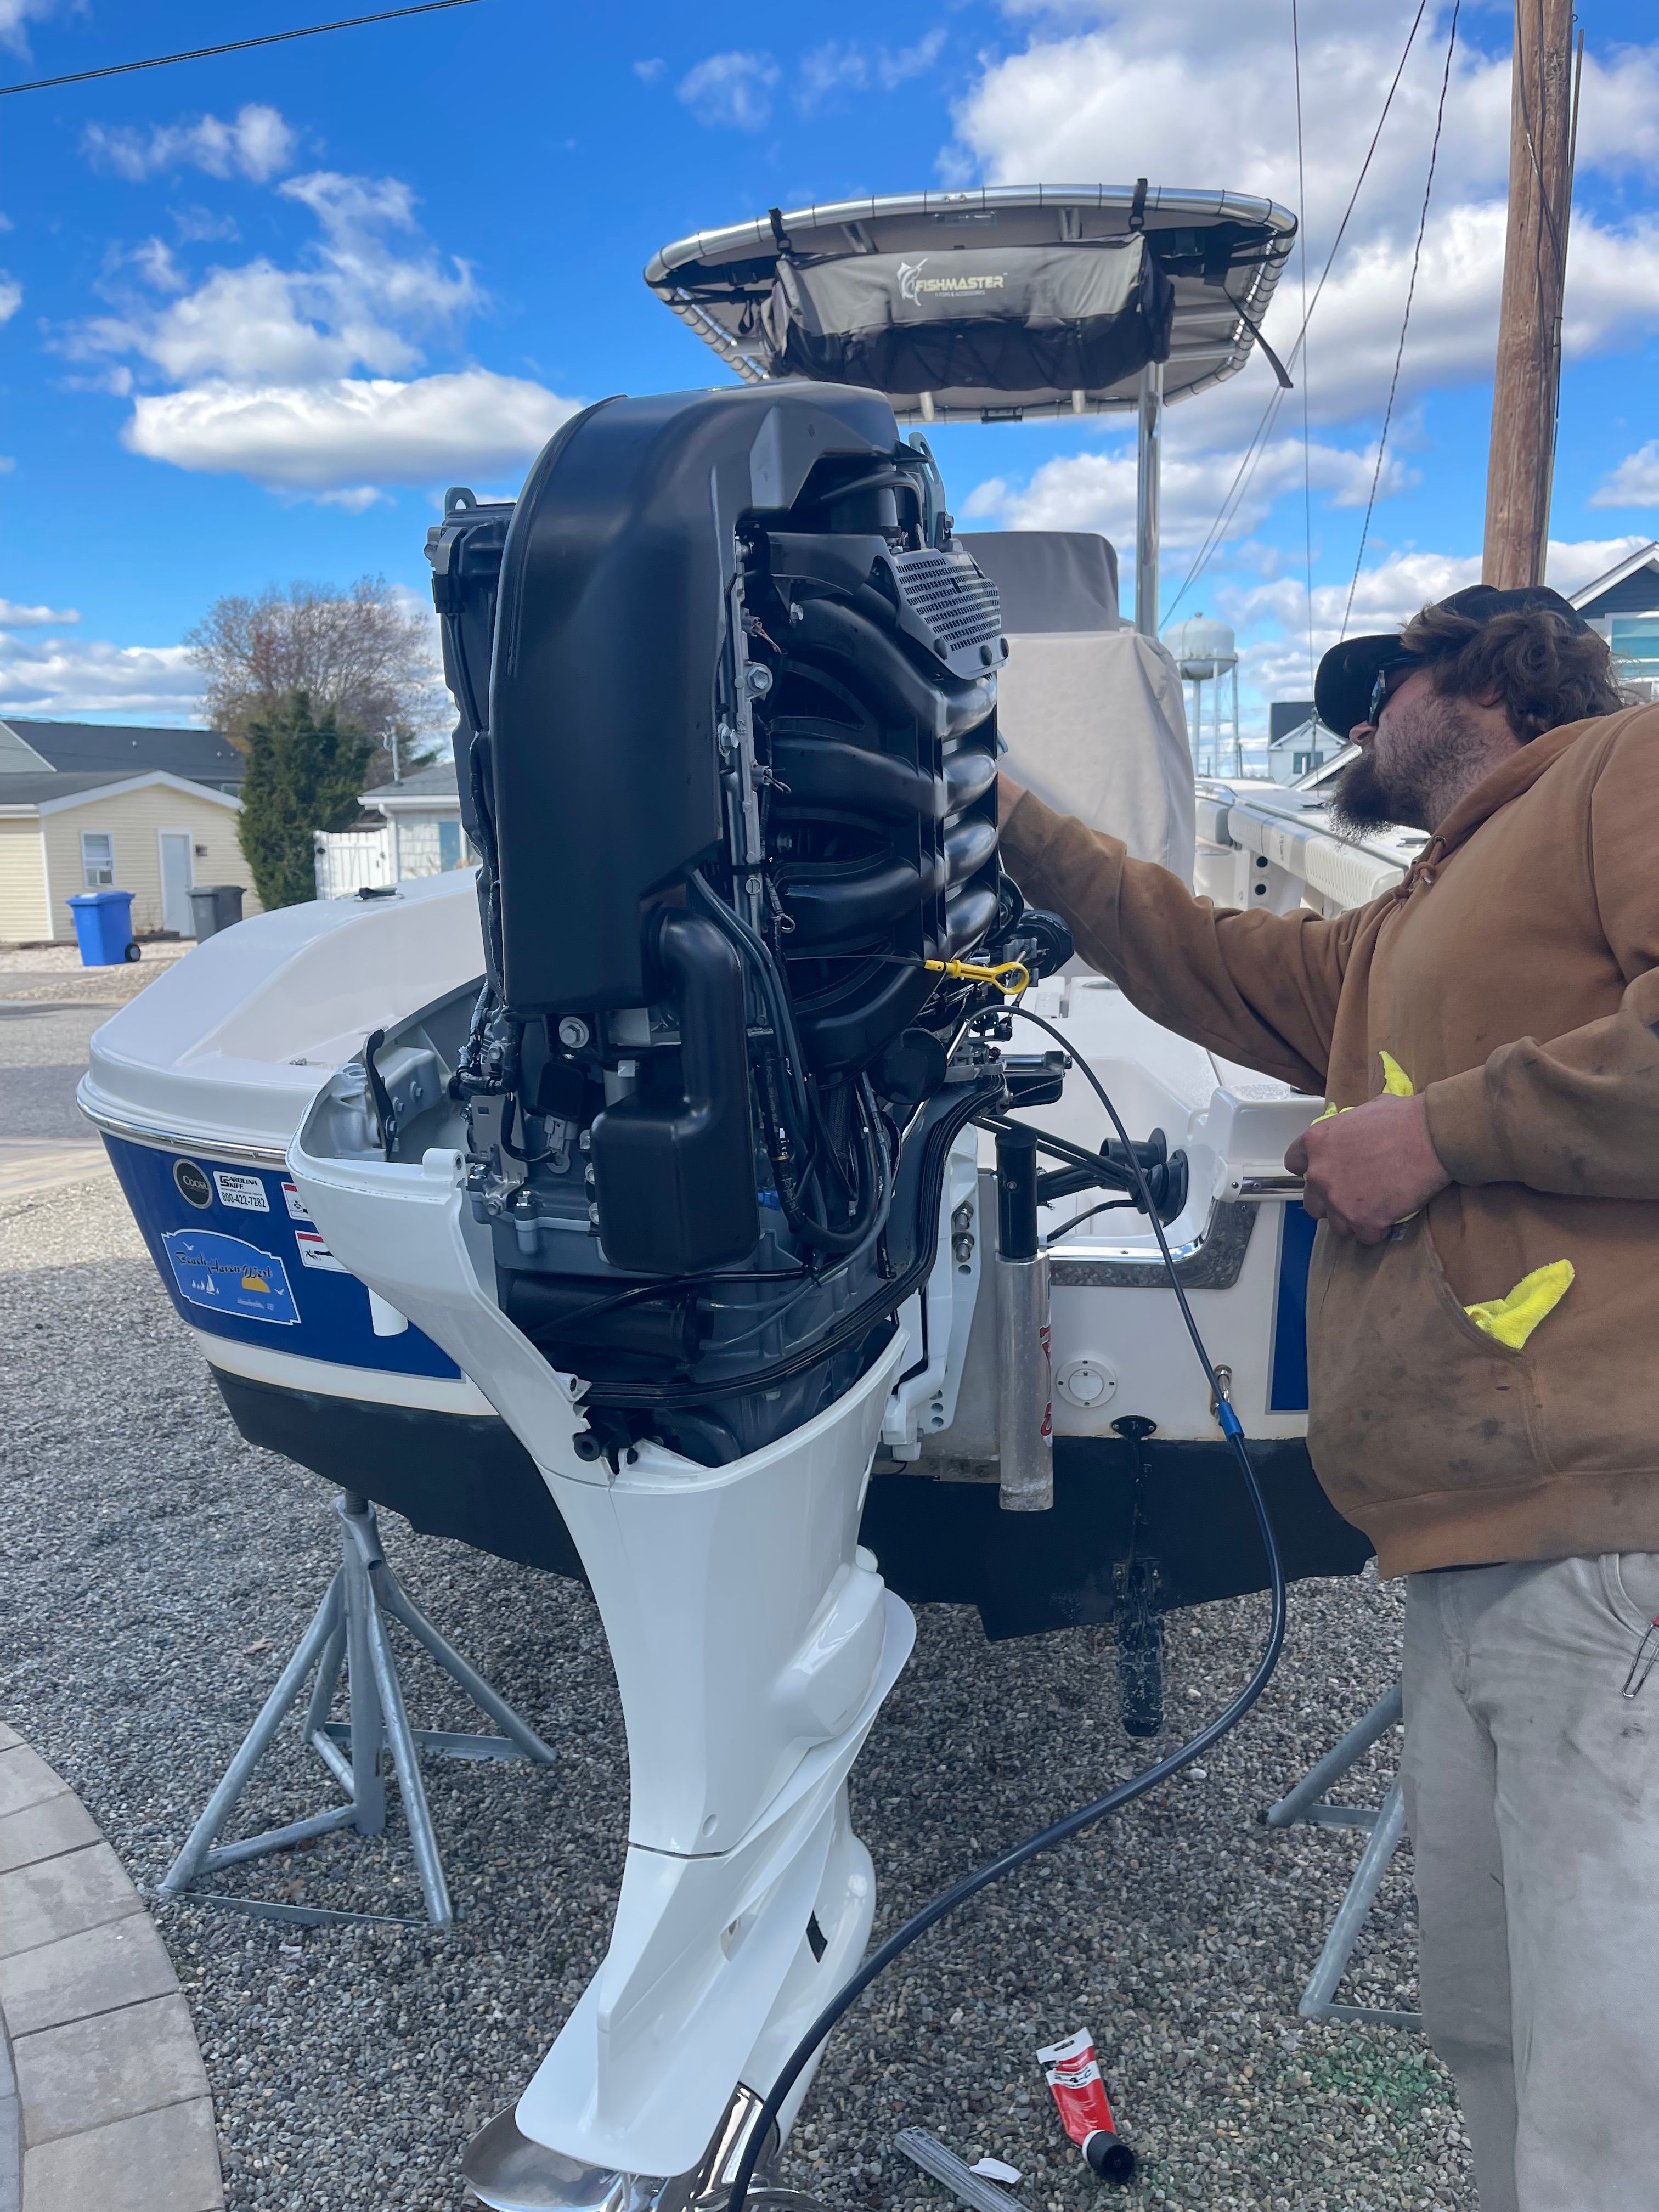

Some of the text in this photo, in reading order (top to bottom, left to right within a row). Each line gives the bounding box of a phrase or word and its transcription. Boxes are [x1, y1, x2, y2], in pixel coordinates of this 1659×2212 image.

[916, 276, 1004, 292] FISHMASTER
[219, 1175, 258, 1186] CAROLINA
[221, 1192, 267, 1207] 800-422-7282
[174, 1251, 272, 1279] Beach Haven West
